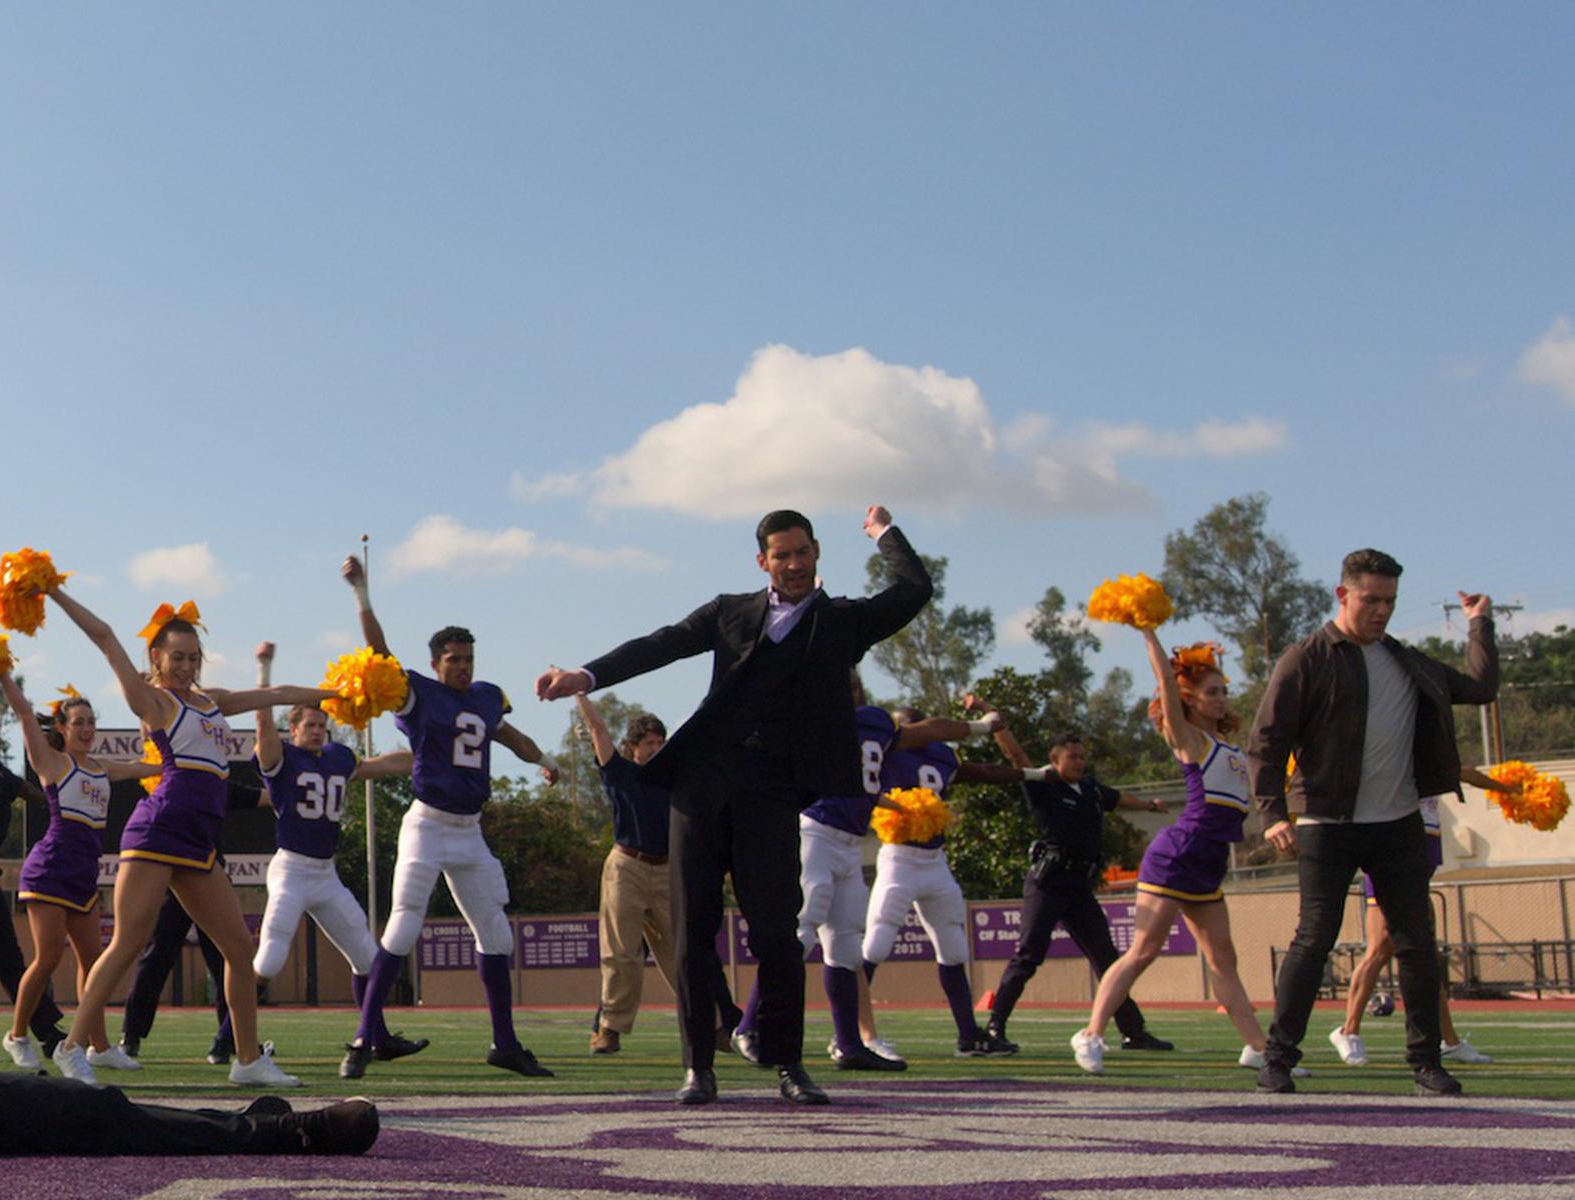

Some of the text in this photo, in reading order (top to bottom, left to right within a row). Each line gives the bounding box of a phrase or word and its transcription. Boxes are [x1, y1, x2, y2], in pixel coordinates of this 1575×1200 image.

[199, 719, 233, 757] CHS
[453, 711, 487, 769] 2
[81, 779, 107, 813] CHS
[295, 771, 347, 823] 30
[548, 923, 590, 933] FOOTBALL
[894, 943, 923, 954] 2015
